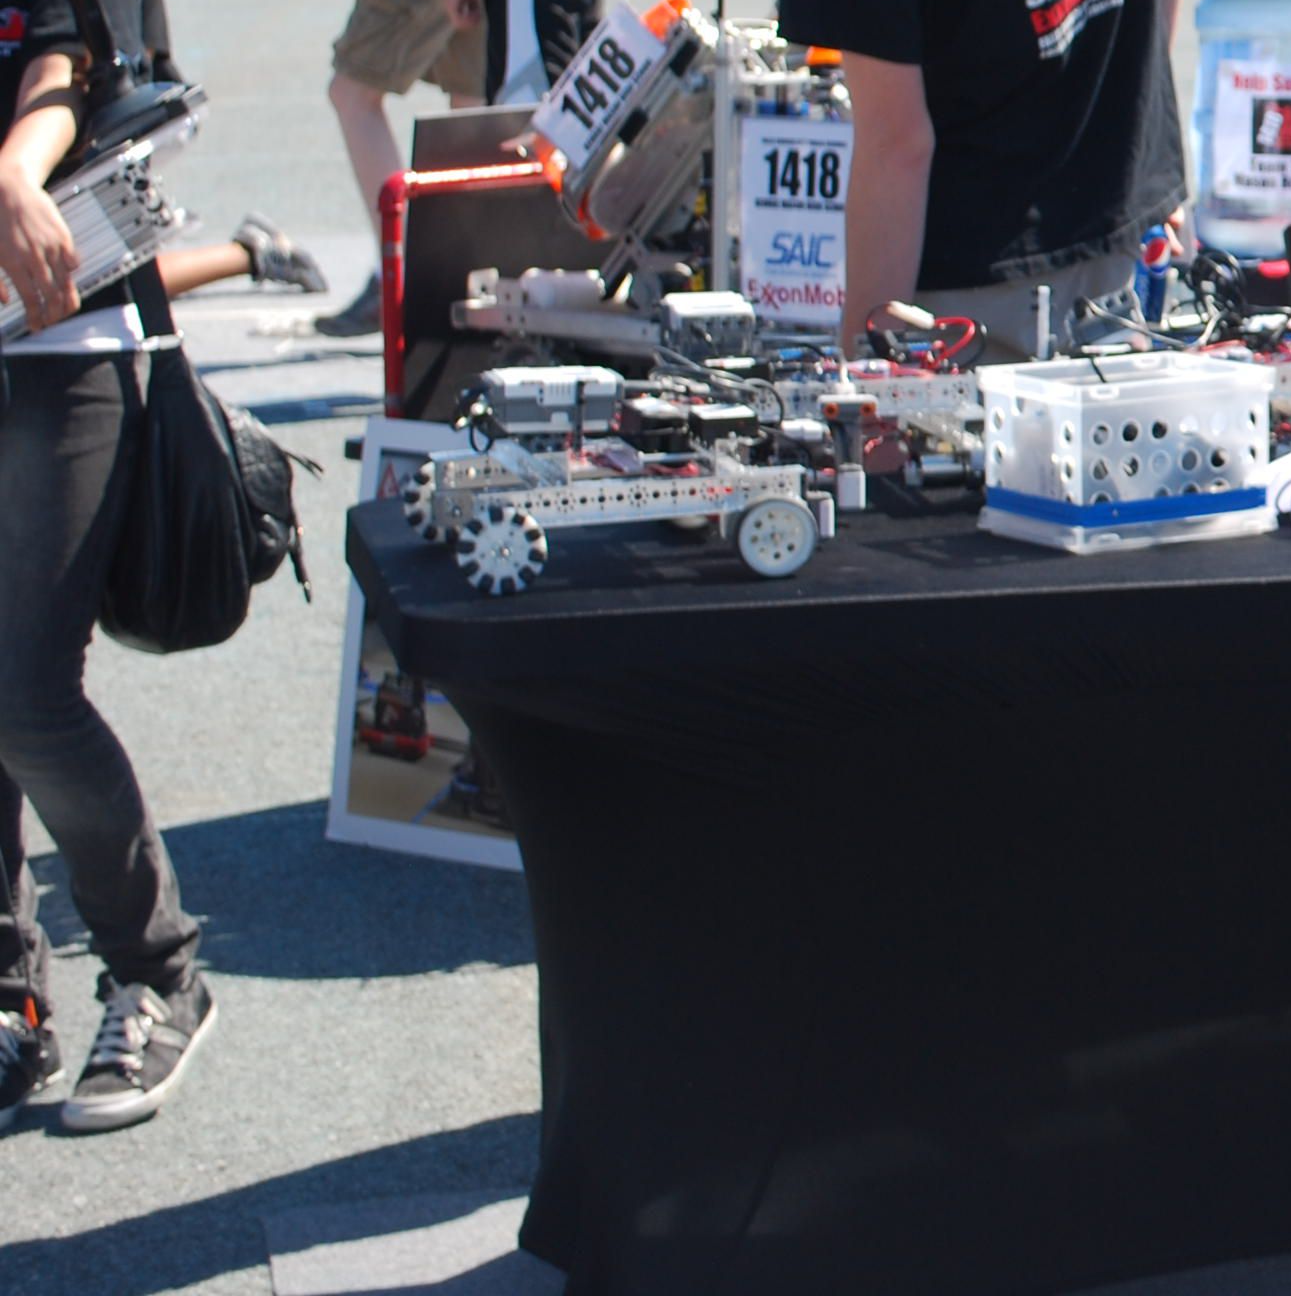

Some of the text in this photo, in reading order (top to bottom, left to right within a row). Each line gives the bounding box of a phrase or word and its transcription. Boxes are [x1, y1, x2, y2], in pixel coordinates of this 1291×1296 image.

[561, 38, 635, 129] 1418
[764, 148, 840, 200] 1418
[766, 232, 836, 268] SAIC
